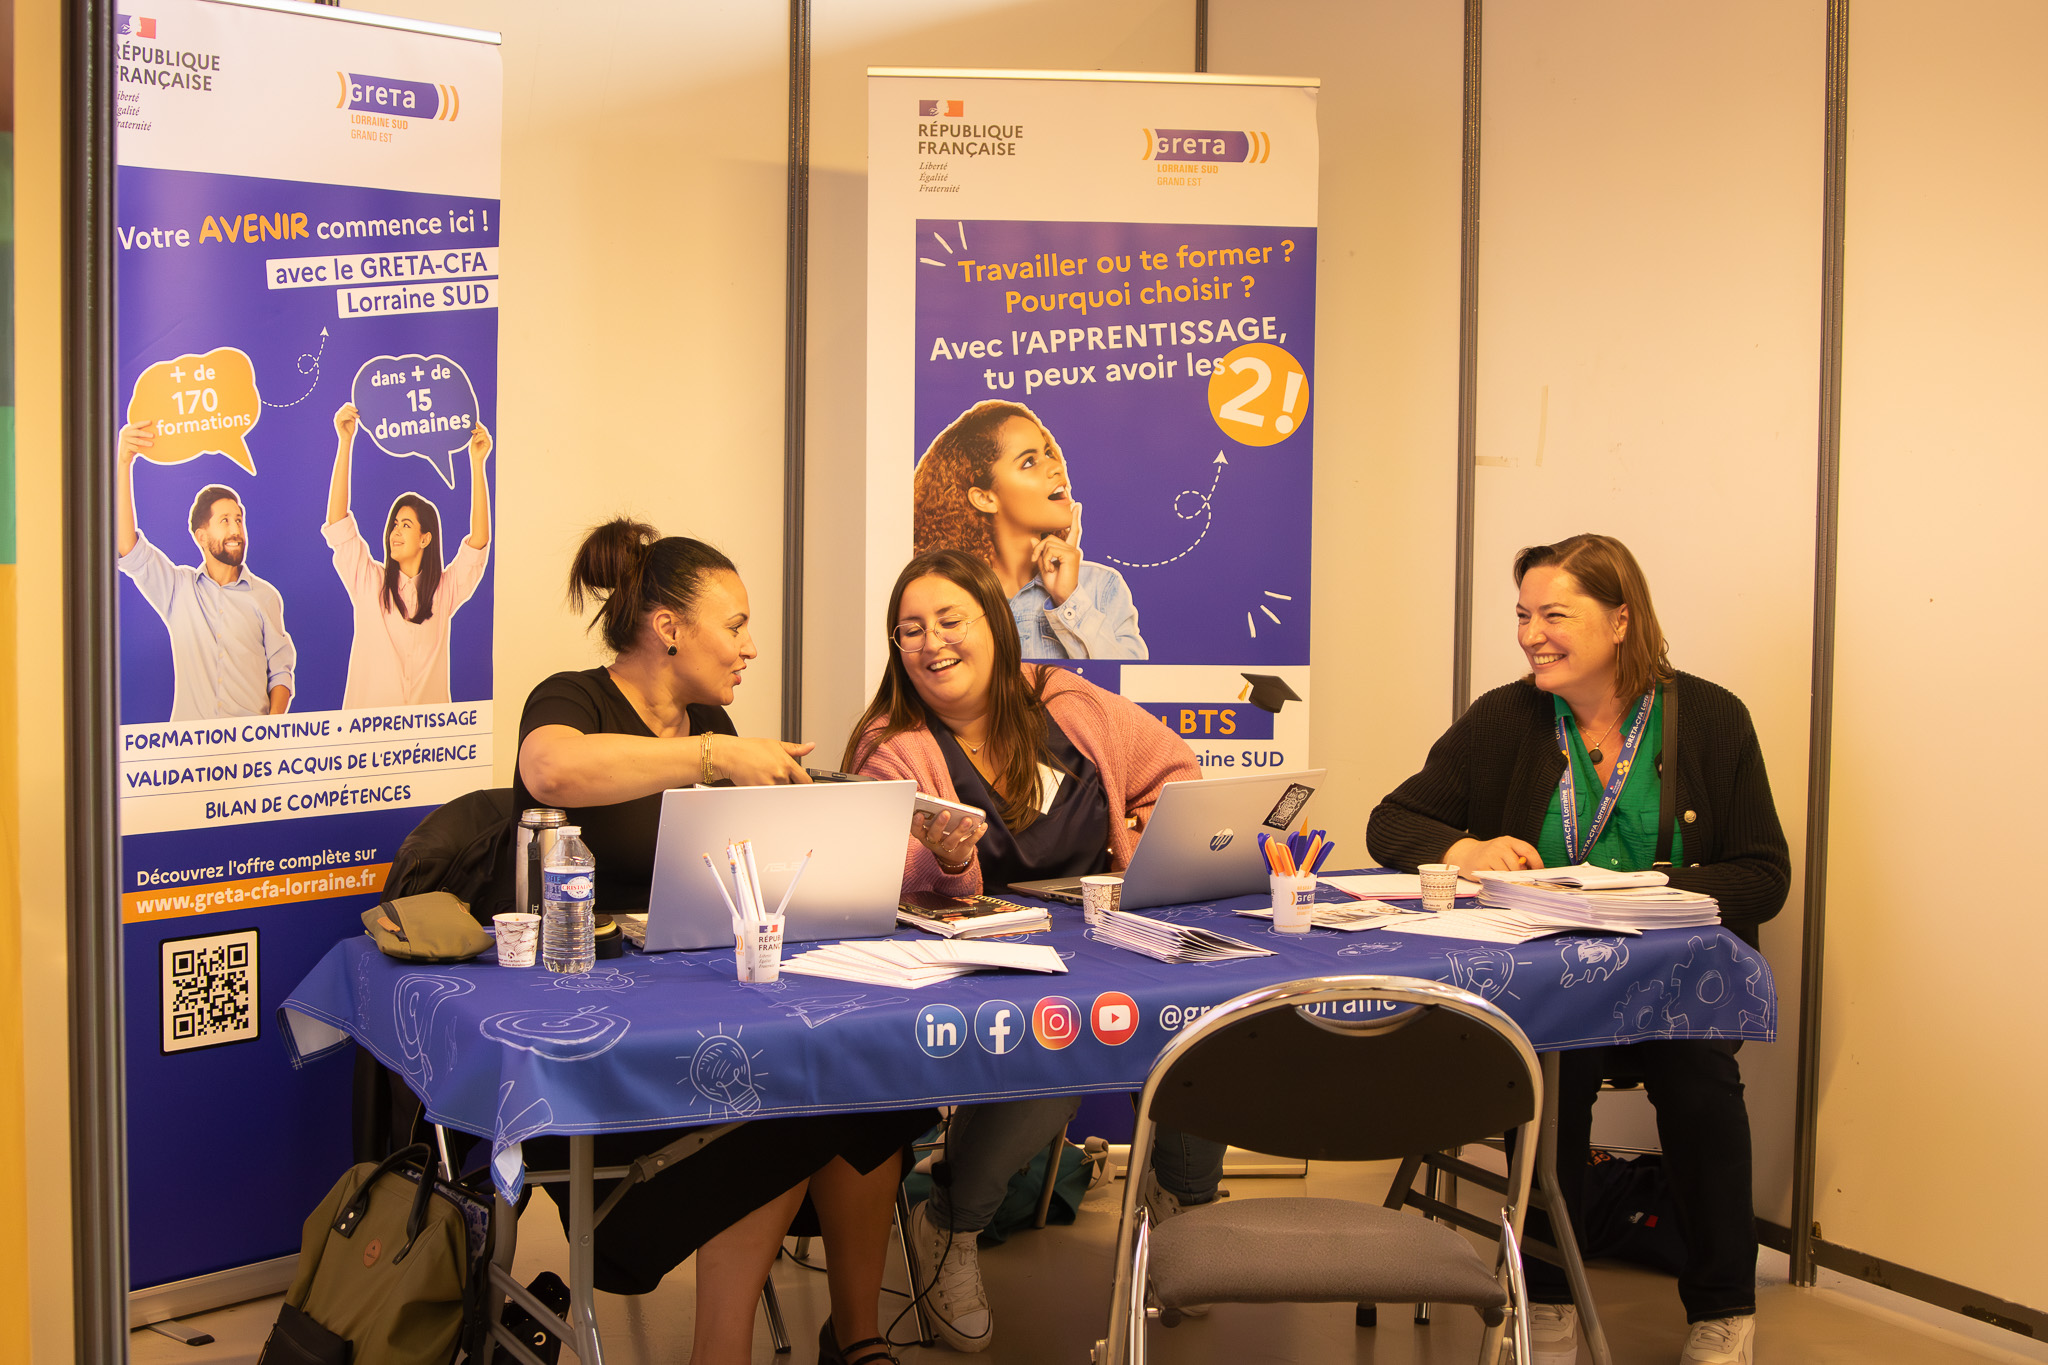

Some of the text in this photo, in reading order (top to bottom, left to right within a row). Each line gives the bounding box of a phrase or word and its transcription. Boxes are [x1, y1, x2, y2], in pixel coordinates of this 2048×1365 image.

[116, 65, 212, 91] RANÇAISE
[117, 91, 140, 102] iberté
[117, 105, 140, 116] galité
[351, 114, 409, 130] LORRAINE SUD
[117, 119, 152, 131] raternité
[351, 129, 393, 143] GRAND EST
[918, 121, 1024, 141] RÉPUBLIQUE
[918, 141, 1016, 158] FRANÇAISE
[919, 161, 948, 170] Liberté
[919, 172, 948, 183] Égalité
[1157, 164, 1219, 174] LORRAINE SUD
[919, 184, 960, 193] Fraternité
[1157, 177, 1202, 186] GRAND EST
[118, 226, 190, 250] Votre
[199, 212, 310, 244] AVENIR
[316, 215, 442, 239] commence
[449, 210, 476, 233] ici
[276, 252, 488, 284] avec le GRETA-CFA
[957, 240, 1295, 282] Travailler ou te former ?
[347, 284, 489, 313] Lorraine SUD
[1005, 275, 1255, 315] Pourquoi choisir ?
[930, 316, 1287, 361] Avec l'APPRENTISSAGE,
[193, 364, 216, 381] de
[371, 370, 407, 387] dans
[431, 363, 451, 380] de
[983, 352, 1226, 395] tu peux avoir les
[171, 388, 218, 415] 170
[406, 388, 432, 412] 15
[156, 412, 251, 436] formations
[375, 411, 471, 439] domaines
[125, 710, 477, 751] FORMATION CONTINUE APPRENTISSAGE
[1180, 709, 1237, 735] BTS
[127, 743, 477, 788] VALIDATION DES ACQUIS DE L'EXPÉRIENCE
[1195, 749, 1284, 768] aine SUD
[206, 784, 411, 819] BILAN DE COMPÉTENCES
[137, 848, 377, 886] Découvrez l'offre complète sur
[136, 869, 376, 914] www.greta-cfa-lorraine.fr
